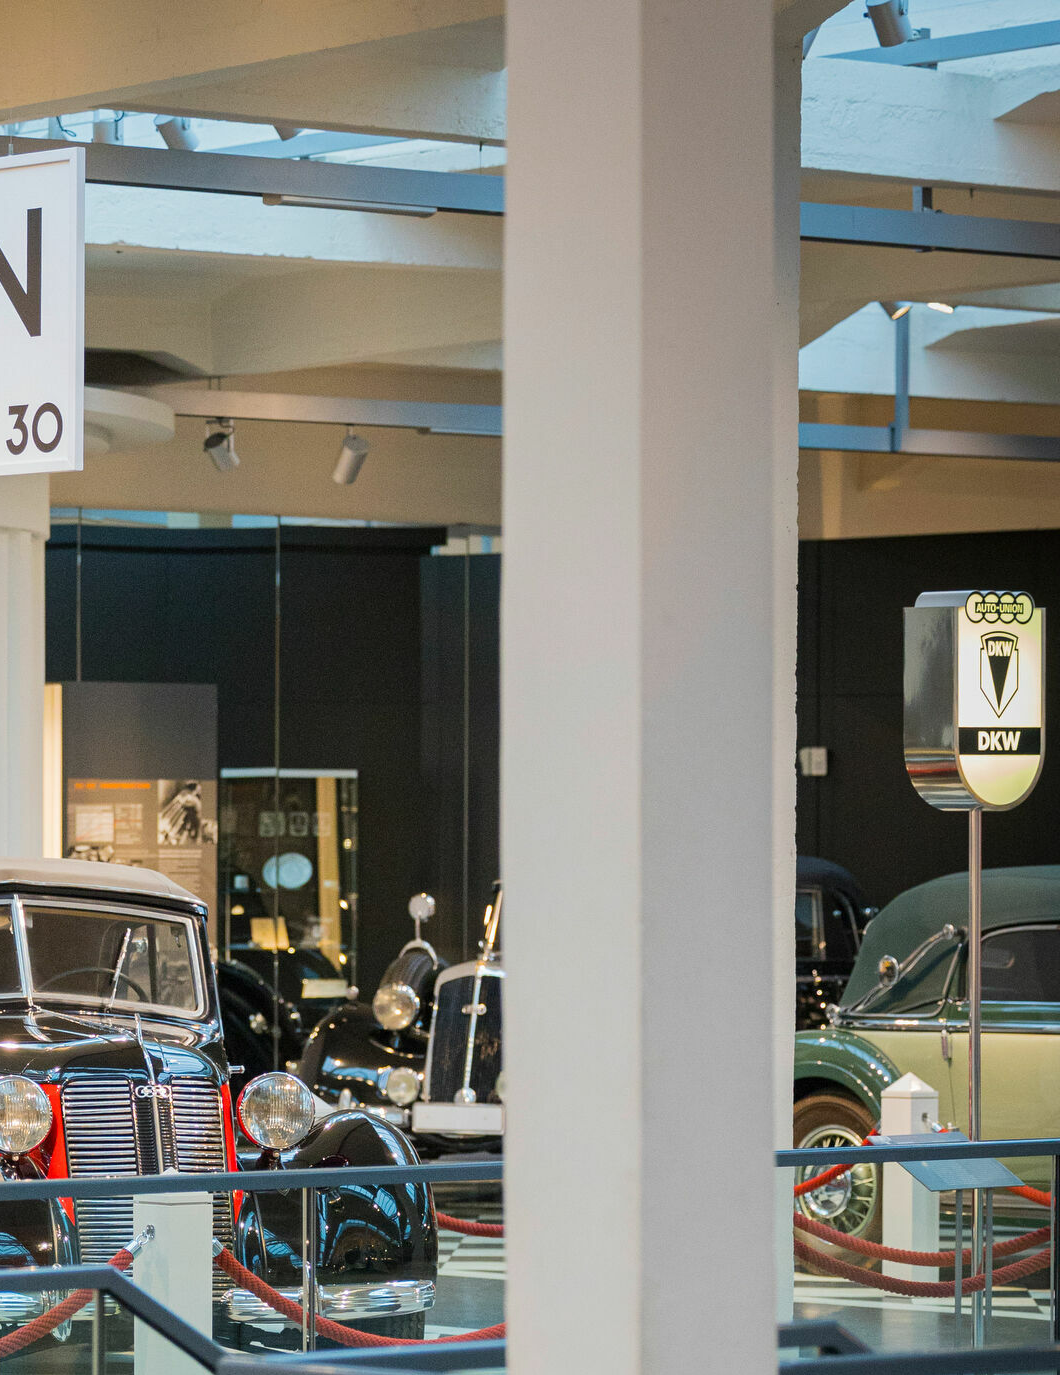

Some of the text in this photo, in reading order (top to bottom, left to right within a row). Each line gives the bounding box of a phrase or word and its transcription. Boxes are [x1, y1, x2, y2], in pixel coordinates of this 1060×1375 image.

[6, 402, 63, 456] 30
[976, 603, 1023, 614] AUTO-UNION
[987, 640, 1013, 657] DKW
[977, 730, 1021, 751] DKW
